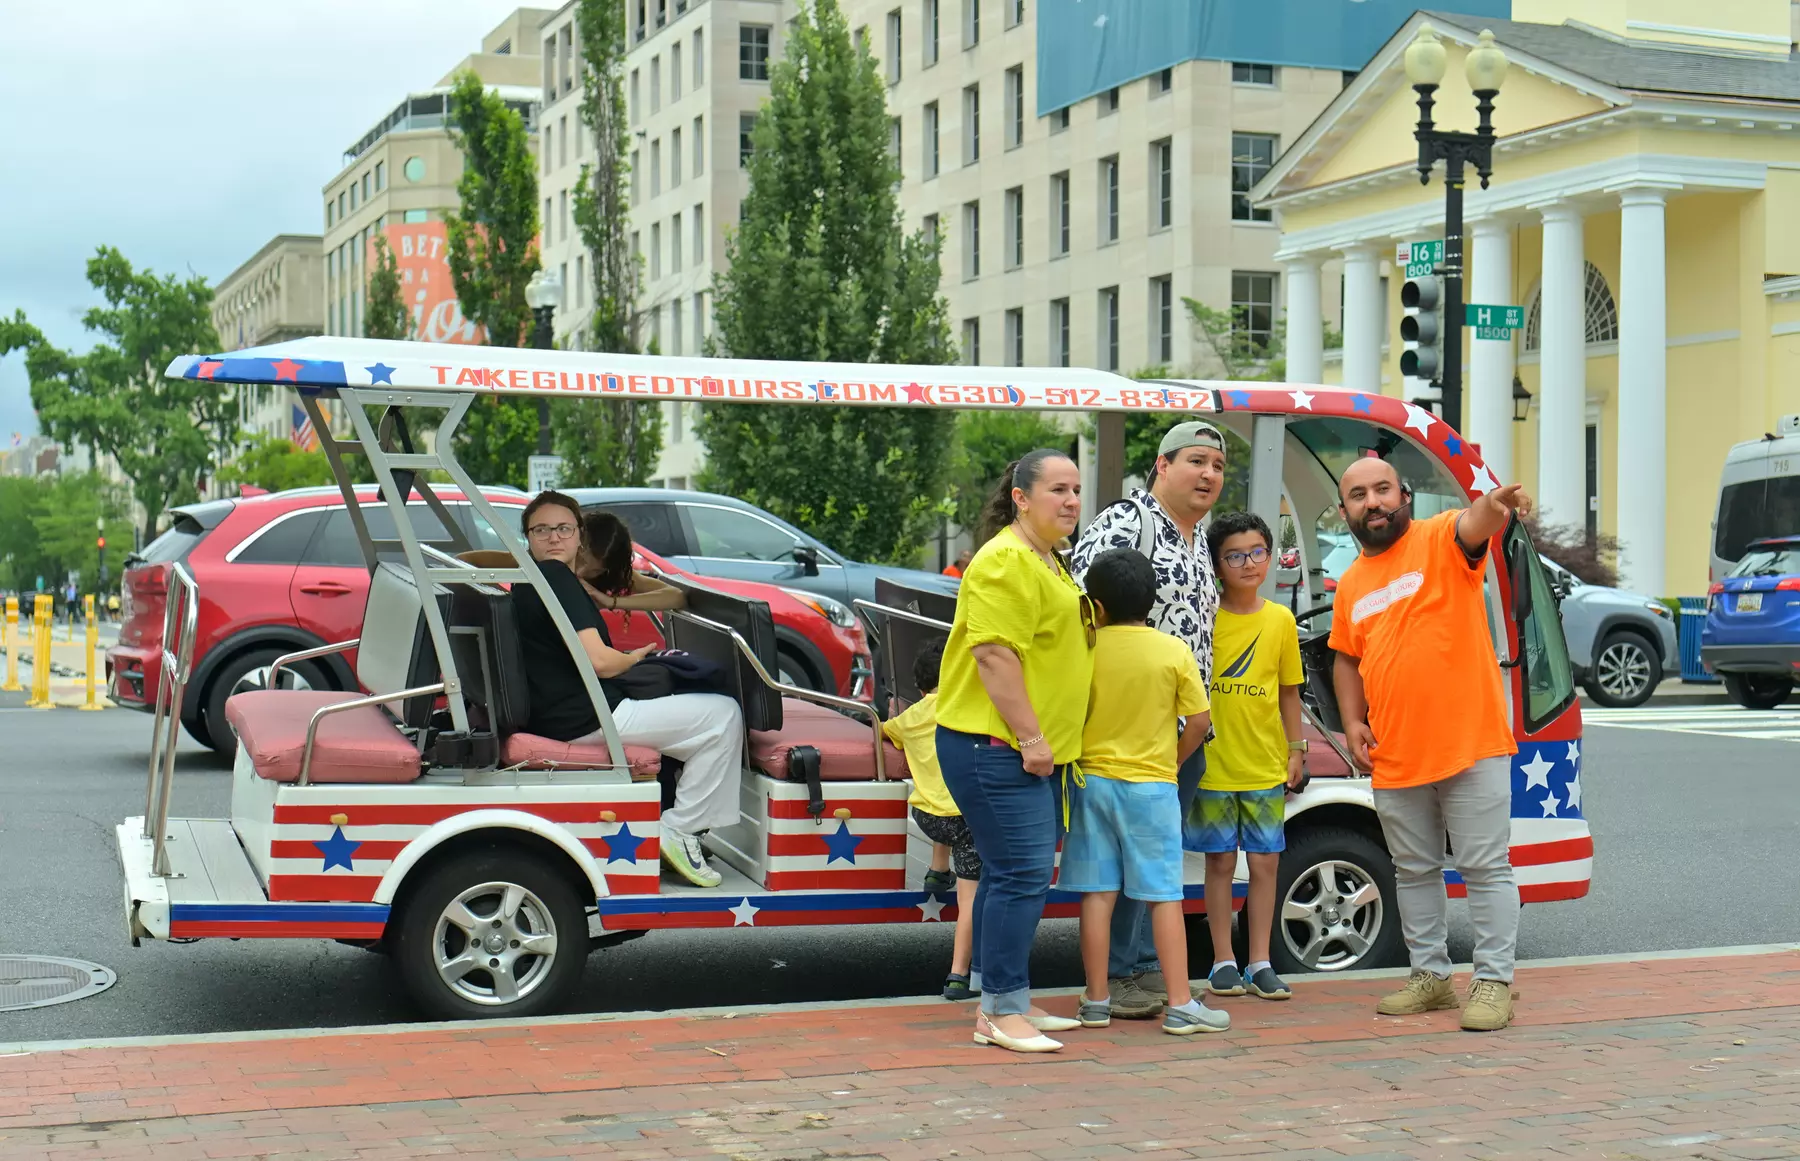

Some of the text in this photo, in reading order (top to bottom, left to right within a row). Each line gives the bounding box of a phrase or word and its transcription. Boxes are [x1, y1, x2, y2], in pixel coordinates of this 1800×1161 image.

[1413, 244, 1429, 261] 16
[1408, 263, 1432, 277] 800
[1478, 307, 1491, 325] H
[1506, 309, 1518, 317] ST
[1505, 317, 1519, 326] NW
[1478, 327, 1510, 339] 1500
[430, 365, 896, 402] TAKEGUIDEDTOURS.COM
[1209, 682, 1268, 698] AUTICA
